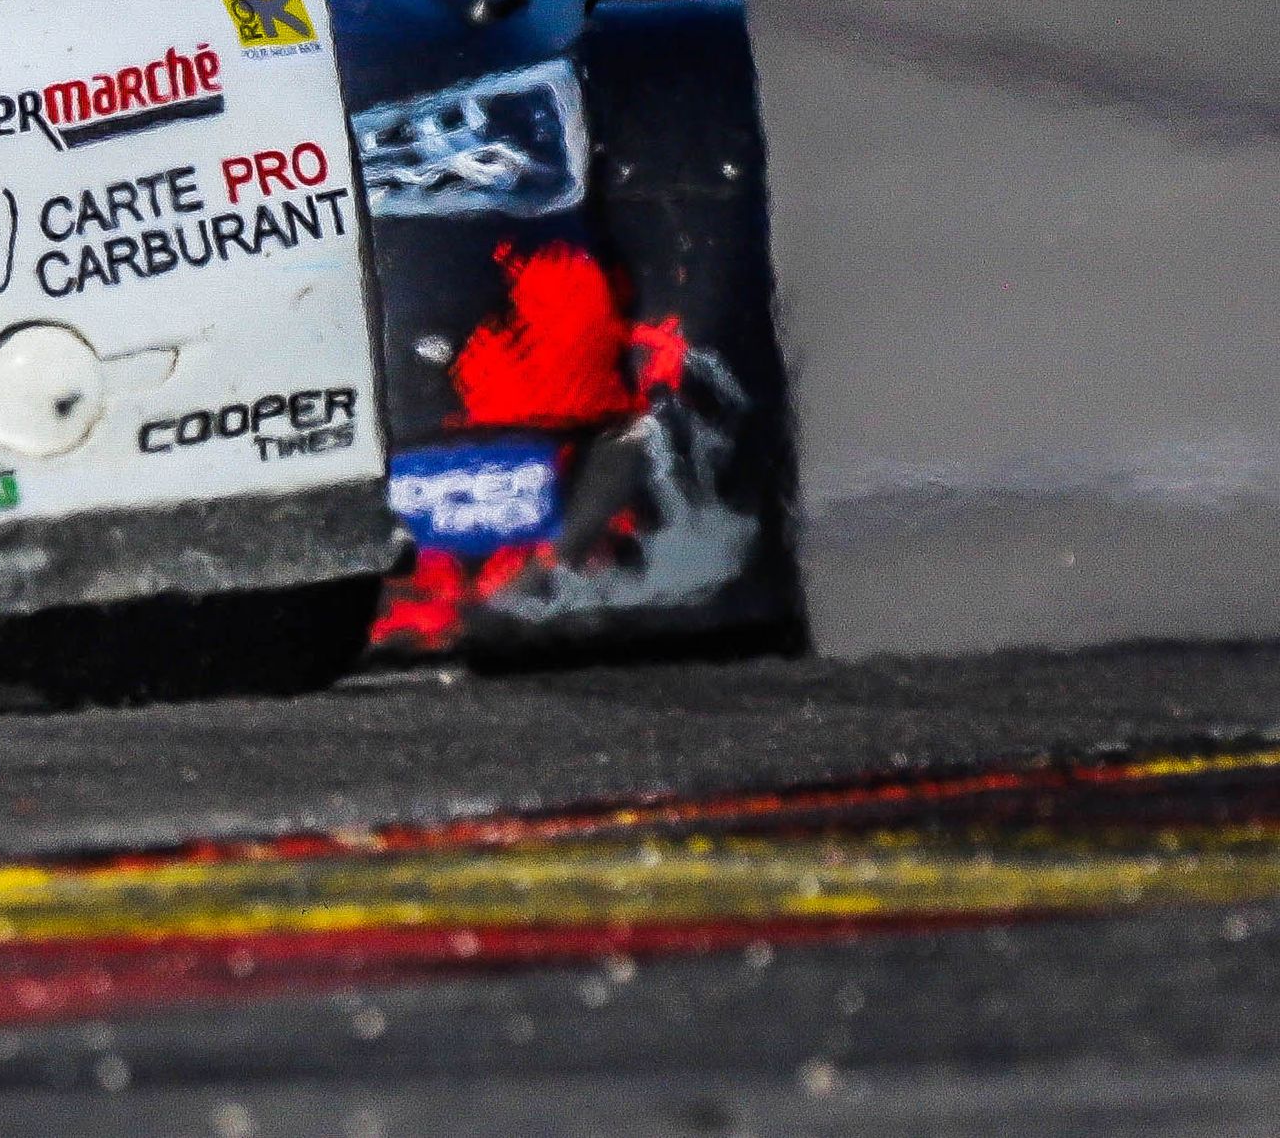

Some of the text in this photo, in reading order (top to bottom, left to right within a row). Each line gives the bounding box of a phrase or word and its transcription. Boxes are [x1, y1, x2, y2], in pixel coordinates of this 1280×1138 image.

[39, 141, 329, 242] CARTE PRO
[35, 188, 350, 298] CARBURANT
[137, 387, 357, 455] COOPER
[253, 424, 355, 462] TIRES
